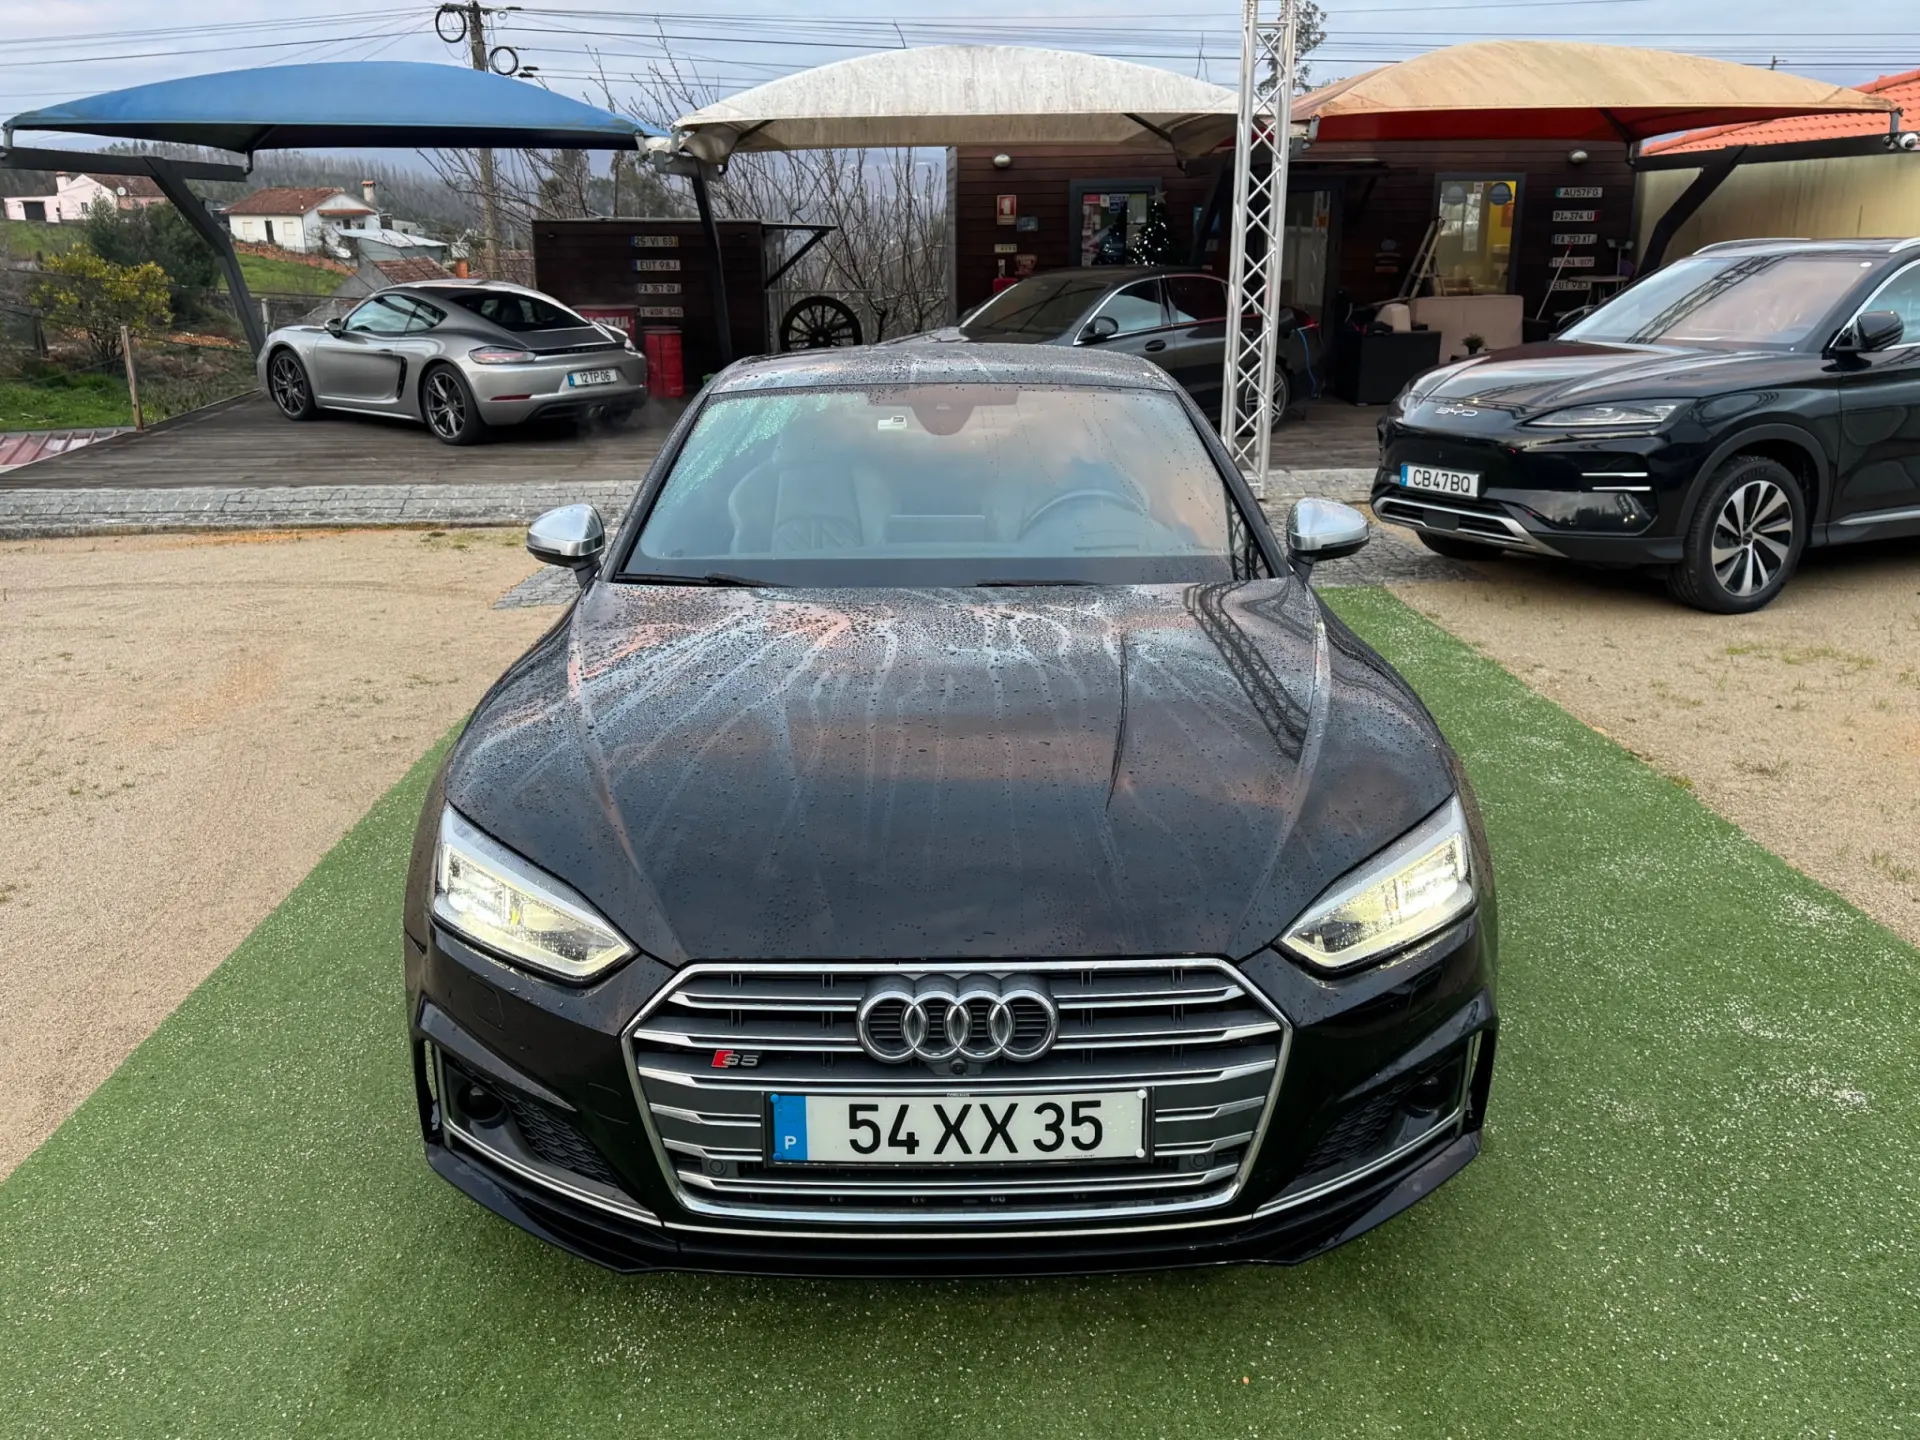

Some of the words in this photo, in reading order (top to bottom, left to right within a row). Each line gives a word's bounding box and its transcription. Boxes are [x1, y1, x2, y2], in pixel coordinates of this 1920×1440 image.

[1435, 407, 1478, 417] BYD
[1413, 469, 1471, 493] CB47BQ
[720, 1052, 759, 1067] S5
[784, 1135, 798, 1150] P
[849, 1103, 919, 1155] 54
[933, 1103, 1019, 1155] XX
[1033, 1100, 1103, 1152] 35
